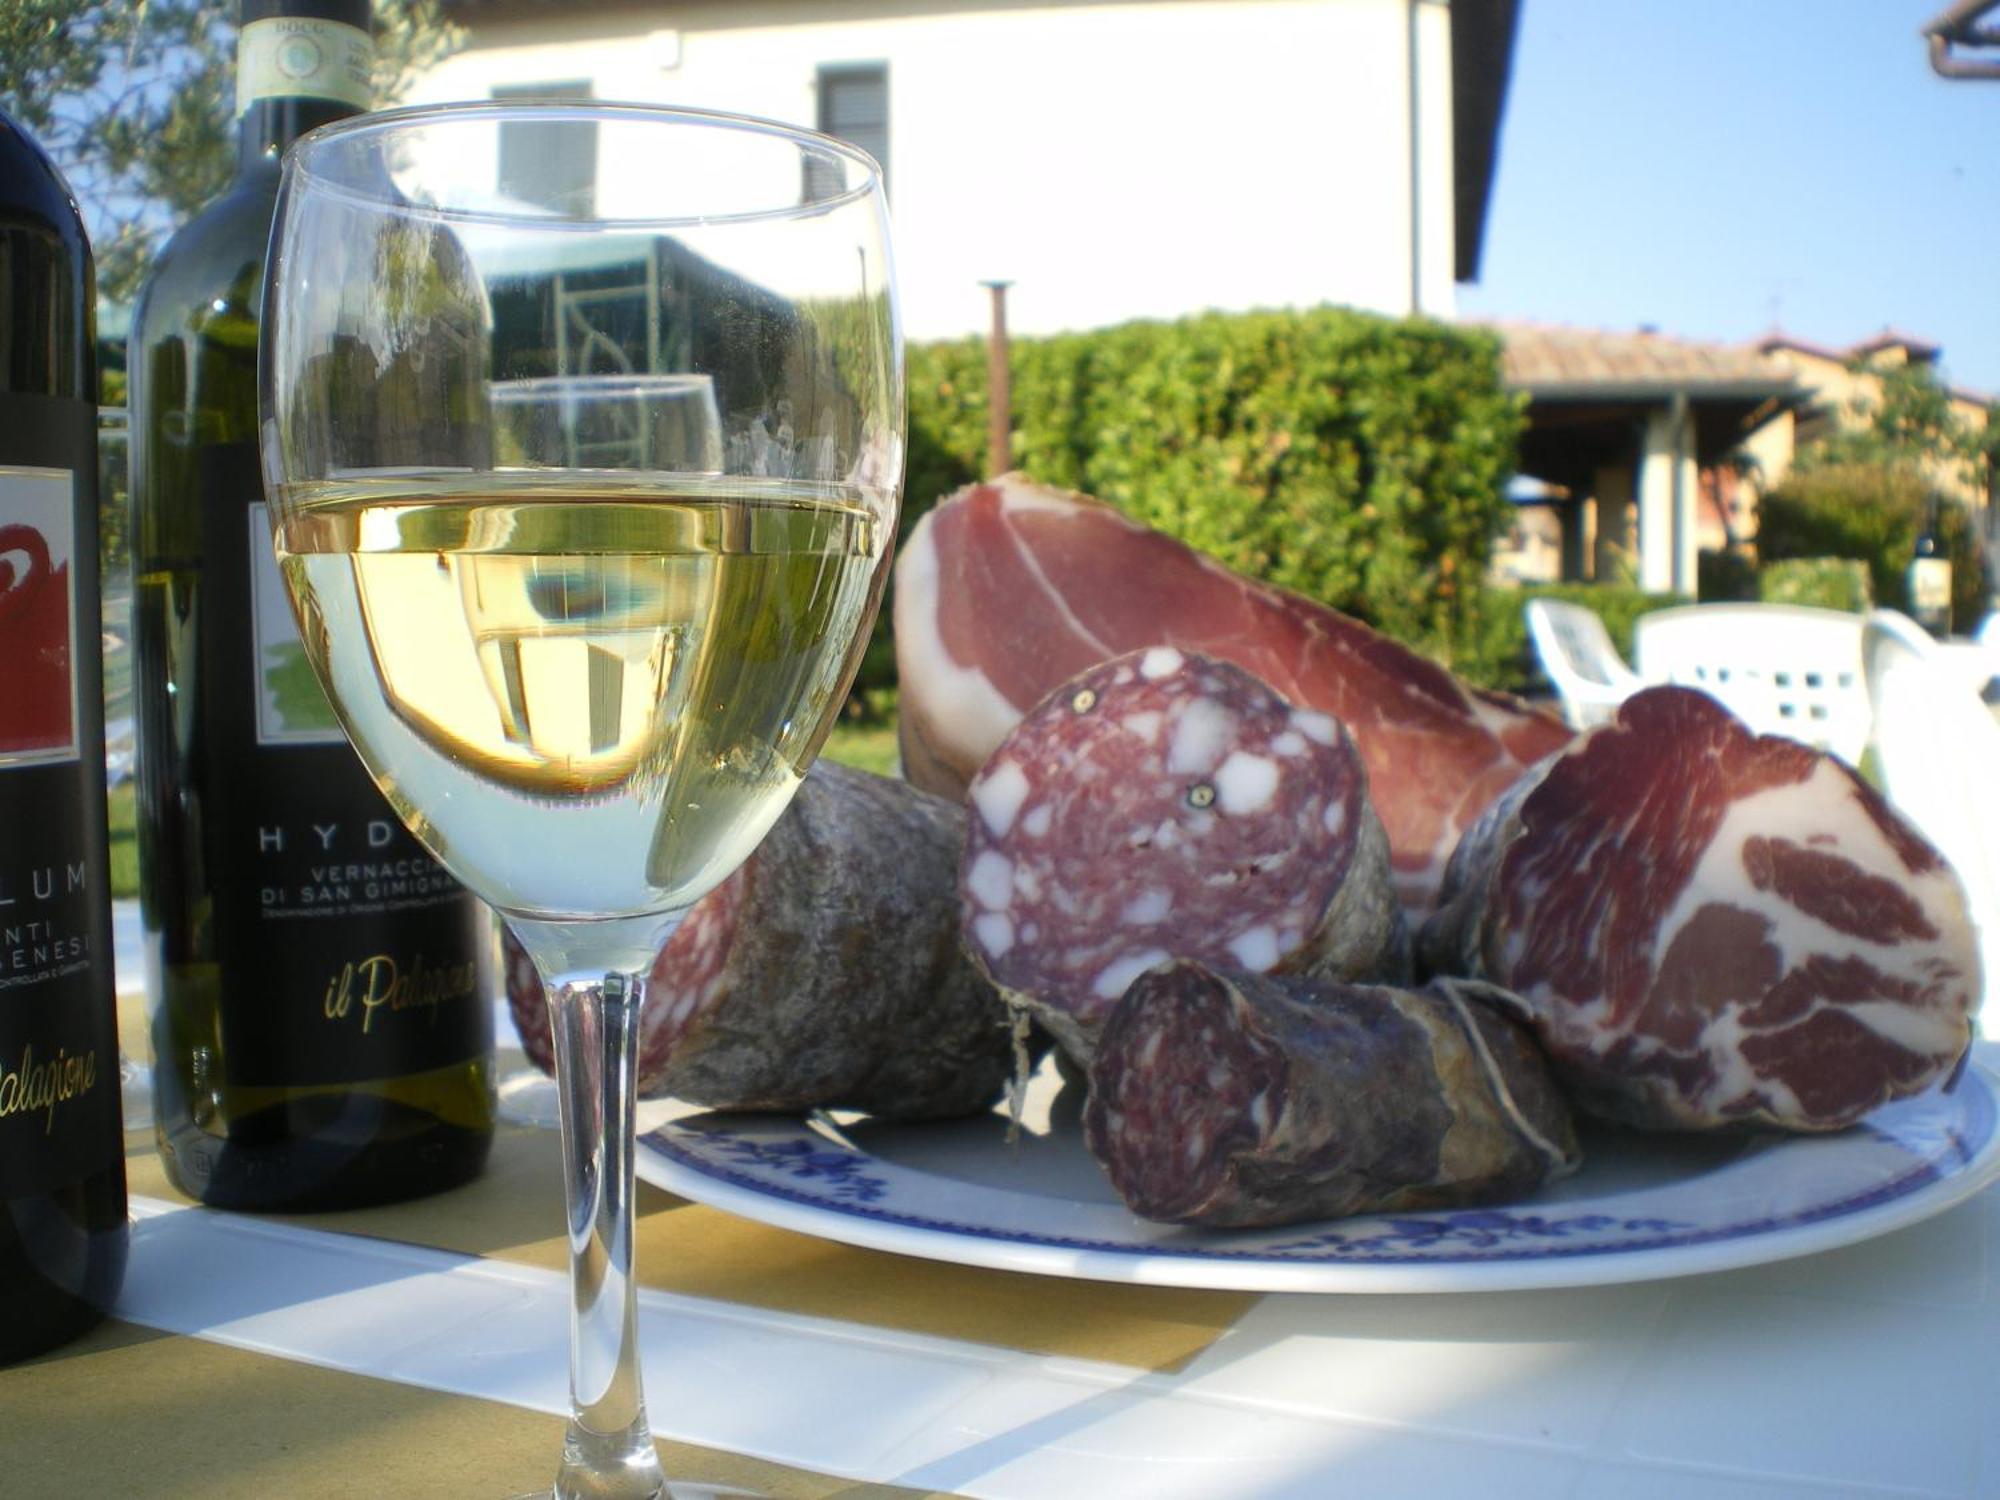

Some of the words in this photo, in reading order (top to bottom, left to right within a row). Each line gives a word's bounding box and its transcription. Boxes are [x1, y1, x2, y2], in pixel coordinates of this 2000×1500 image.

[261, 887, 284, 904] DI
[301, 884, 351, 904] SAN
[0, 932, 90, 969] ENESI
[324, 962, 352, 1019] il
[0, 1042, 96, 1135] alagione
